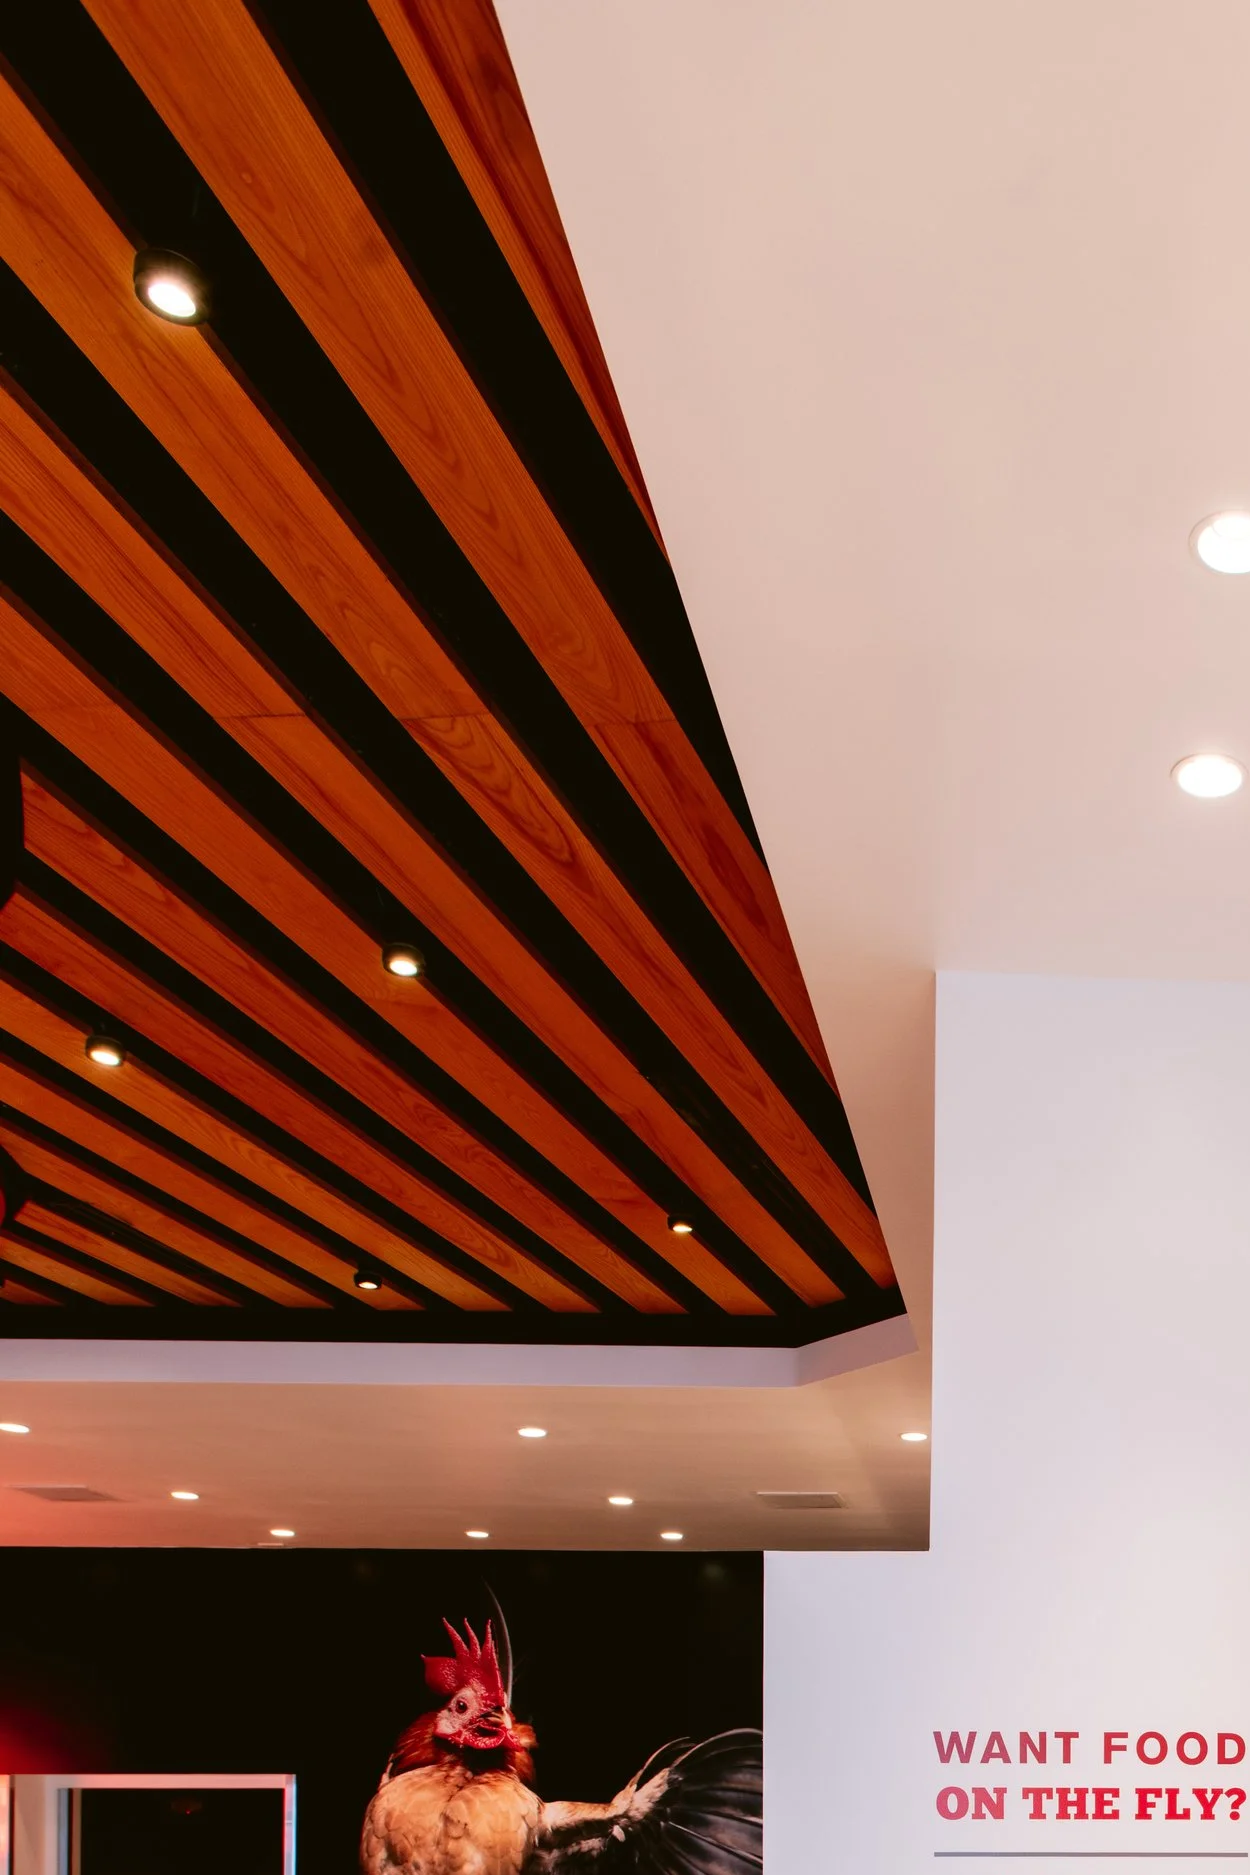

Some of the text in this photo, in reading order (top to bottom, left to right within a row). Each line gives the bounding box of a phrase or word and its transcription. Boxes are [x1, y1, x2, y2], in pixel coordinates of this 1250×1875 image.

[933, 1731, 1246, 1765] WANT FOOD
[936, 1786, 1247, 1821] ON THE FLY?
